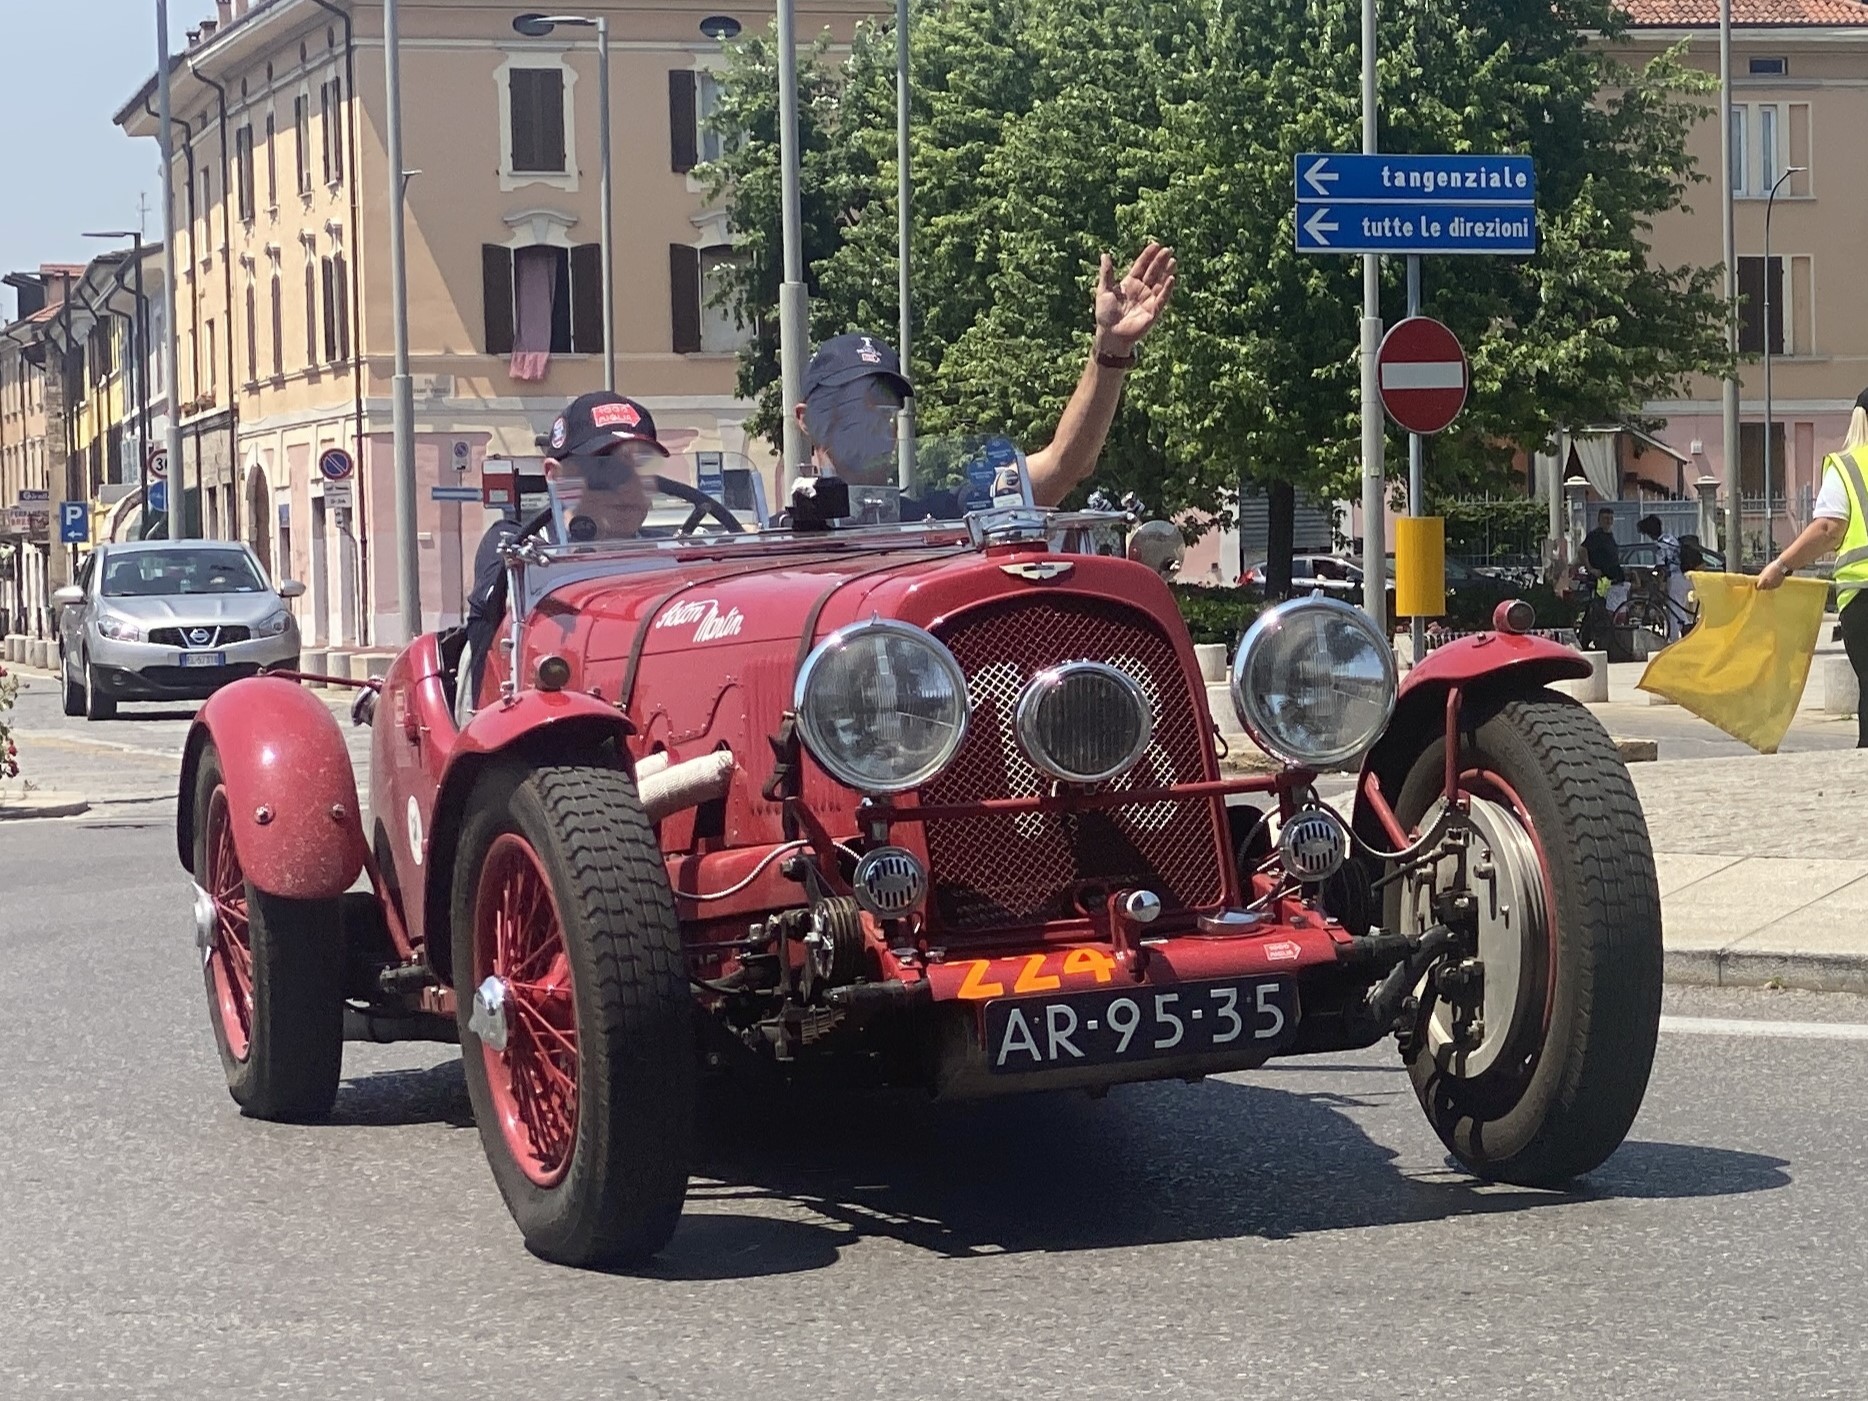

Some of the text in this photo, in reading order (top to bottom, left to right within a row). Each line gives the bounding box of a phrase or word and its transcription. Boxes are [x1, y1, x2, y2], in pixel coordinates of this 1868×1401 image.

[1381, 165, 1527, 193] tangenziale
[1361, 215, 1529, 238] tutte le direzioni
[155, 457, 167, 472] 3
[66, 506, 82, 526] P
[655, 599, 744, 642] Aston Martin
[944, 948, 1116, 999] 224
[996, 983, 1285, 1066] AR-95-35
